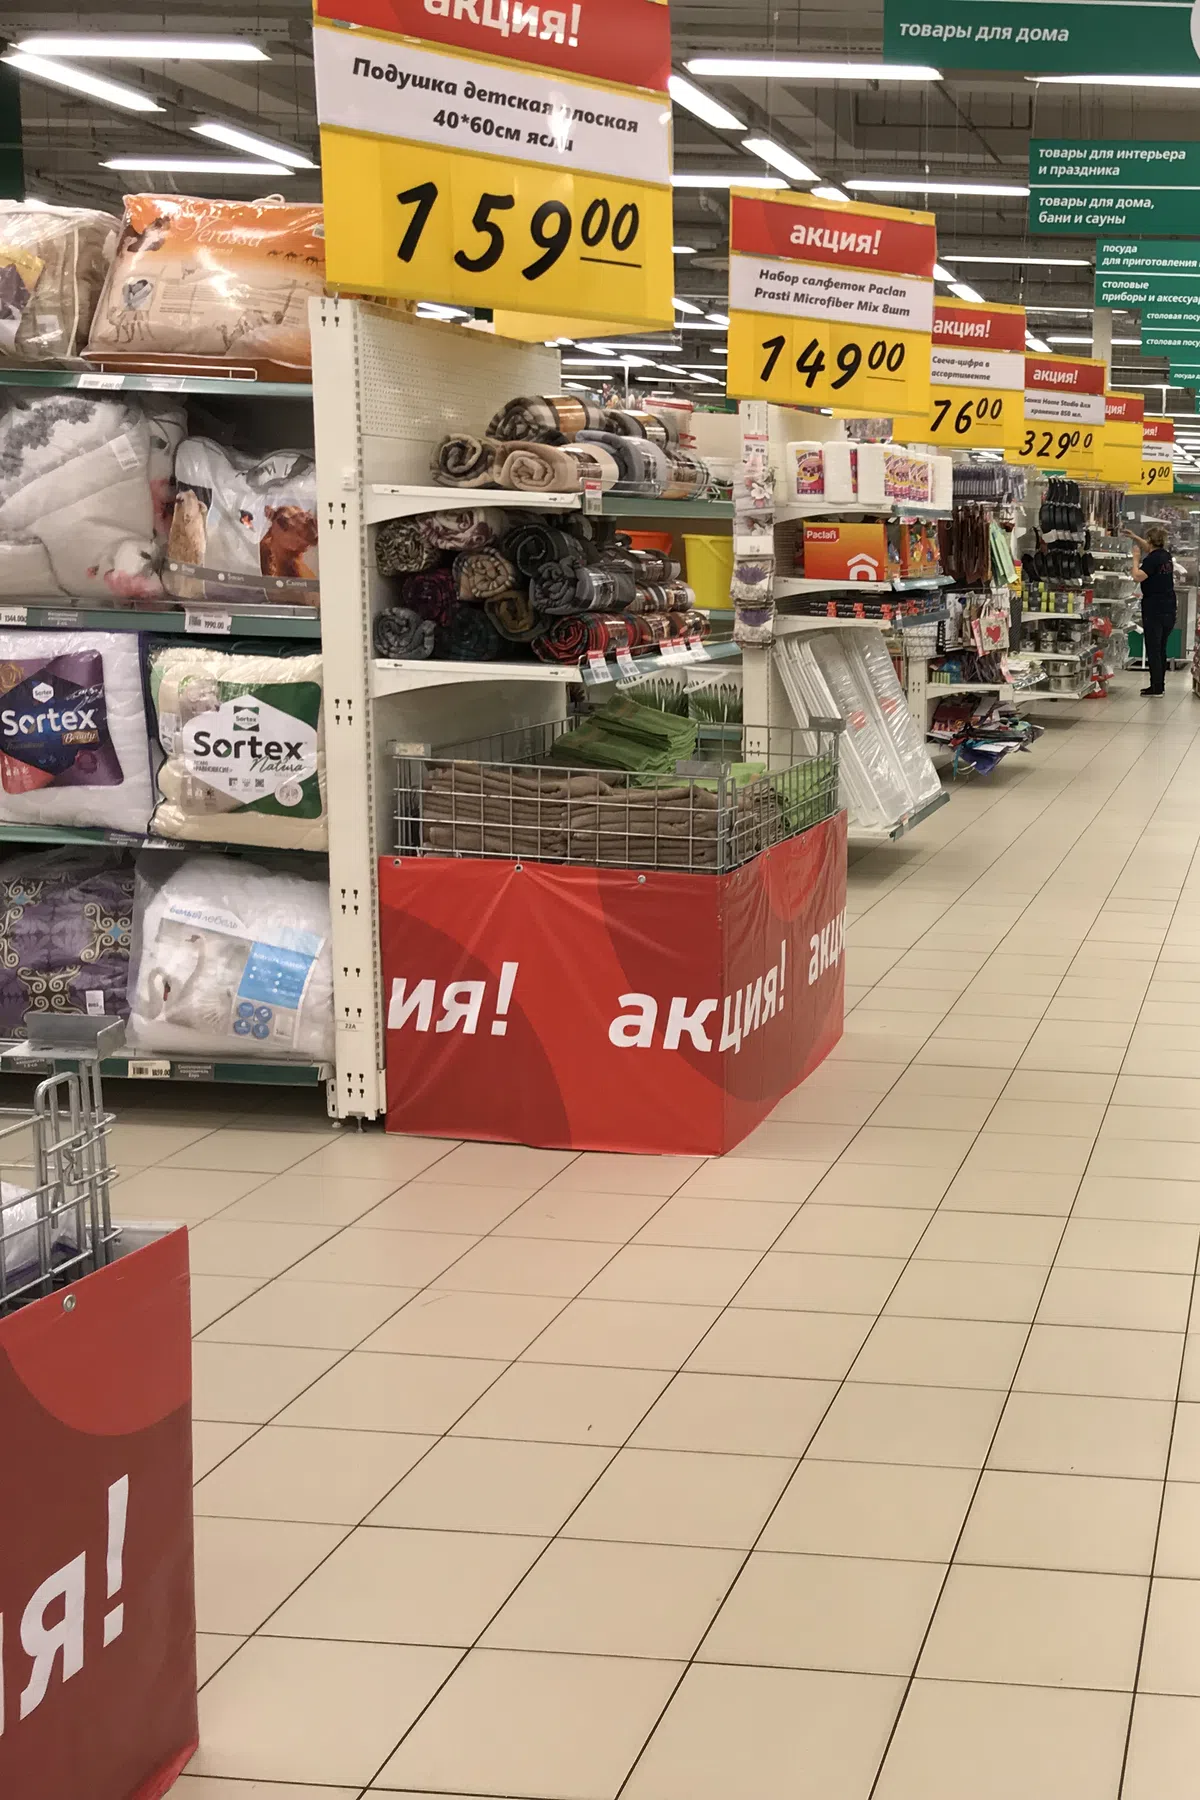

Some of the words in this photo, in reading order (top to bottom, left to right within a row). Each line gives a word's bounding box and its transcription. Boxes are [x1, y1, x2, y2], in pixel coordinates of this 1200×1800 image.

[900, 23, 972, 42] товары
[975, 24, 1013, 42] для
[1016, 25, 1070, 43] дома
[352, 57, 458, 95] Подушка
[463, 80, 553, 116] детская
[1039, 147, 1088, 161] товары
[1089, 149, 1114, 161] для
[1116, 150, 1186, 162] интерьера
[1038, 165, 1047, 175] и
[1050, 165, 1120, 177] праздника
[1039, 196, 1088, 208] товары
[1089, 197, 1114, 209] для
[1116, 198, 1155, 210] дома,
[1038, 211, 1072, 224] бани
[1074, 214, 1083, 224] и
[1085, 214, 1126, 227] сауны
[789, 223, 882, 255] акция!
[1102, 244, 1138, 254] посуда
[1102, 256, 1121, 267] для
[1122, 257, 1197, 269] приготовления
[758, 268, 799, 286] Набор
[801, 277, 866, 294] салфеток
[868, 283, 907, 298] Paclan
[1102, 280, 1150, 290] столовые
[753, 287, 791, 301] Prasti
[792, 292, 855, 310] Microfiber
[856, 300, 880, 313] Mix
[881, 303, 911, 317] 8шт
[1101, 290, 1147, 303] приборы
[1148, 293, 1156, 302] и
[1146, 312, 1183, 321] столовая
[932, 318, 992, 340] акция!
[1146, 338, 1183, 347] столовая
[931, 369, 991, 382] ассортименте
[1032, 367, 1079, 385] акция!
[806, 528, 837, 540] Paclan
[0, 708, 98, 737] Sortex
[235, 715, 257, 723] Sortex
[193, 730, 304, 761] Sortex
[387, 961, 520, 1037] ия!
[607, 939, 788, 1055] акция!
[0, 1473, 130, 1737] я!
